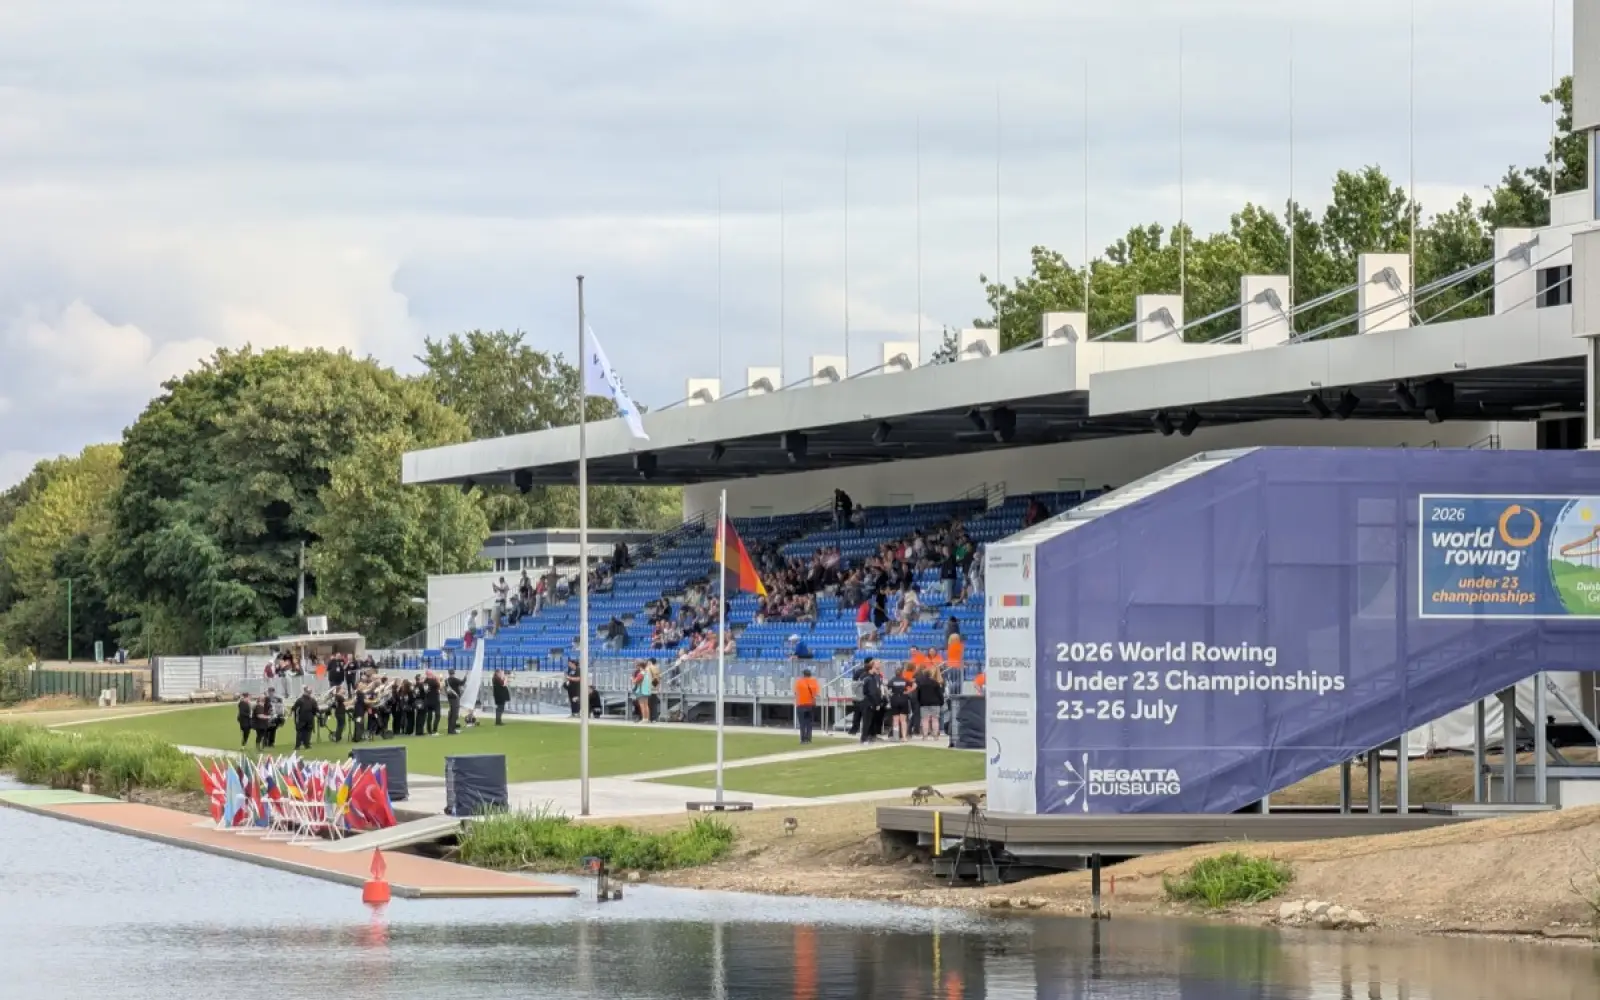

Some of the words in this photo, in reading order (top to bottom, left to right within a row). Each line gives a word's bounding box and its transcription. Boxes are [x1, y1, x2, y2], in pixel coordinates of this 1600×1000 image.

[1432, 508, 1466, 521] 2026
[1432, 526, 1496, 548] world
[1444, 549, 1520, 571] rowing
[1458, 576, 1499, 588] under
[1501, 576, 1519, 588] 23
[1432, 588, 1536, 606] championships
[1056, 642, 1113, 662] 2026
[1118, 641, 1186, 662] World
[1192, 641, 1277, 666] Rowing
[1056, 670, 1128, 691] Under
[1132, 671, 1159, 691] 23
[1164, 670, 1345, 696] Championships
[1056, 700, 1125, 720] 23-26
[1130, 699, 1178, 724] July
[1089, 769, 1180, 782] REGATTA
[1089, 782, 1180, 795] DUISBURG
